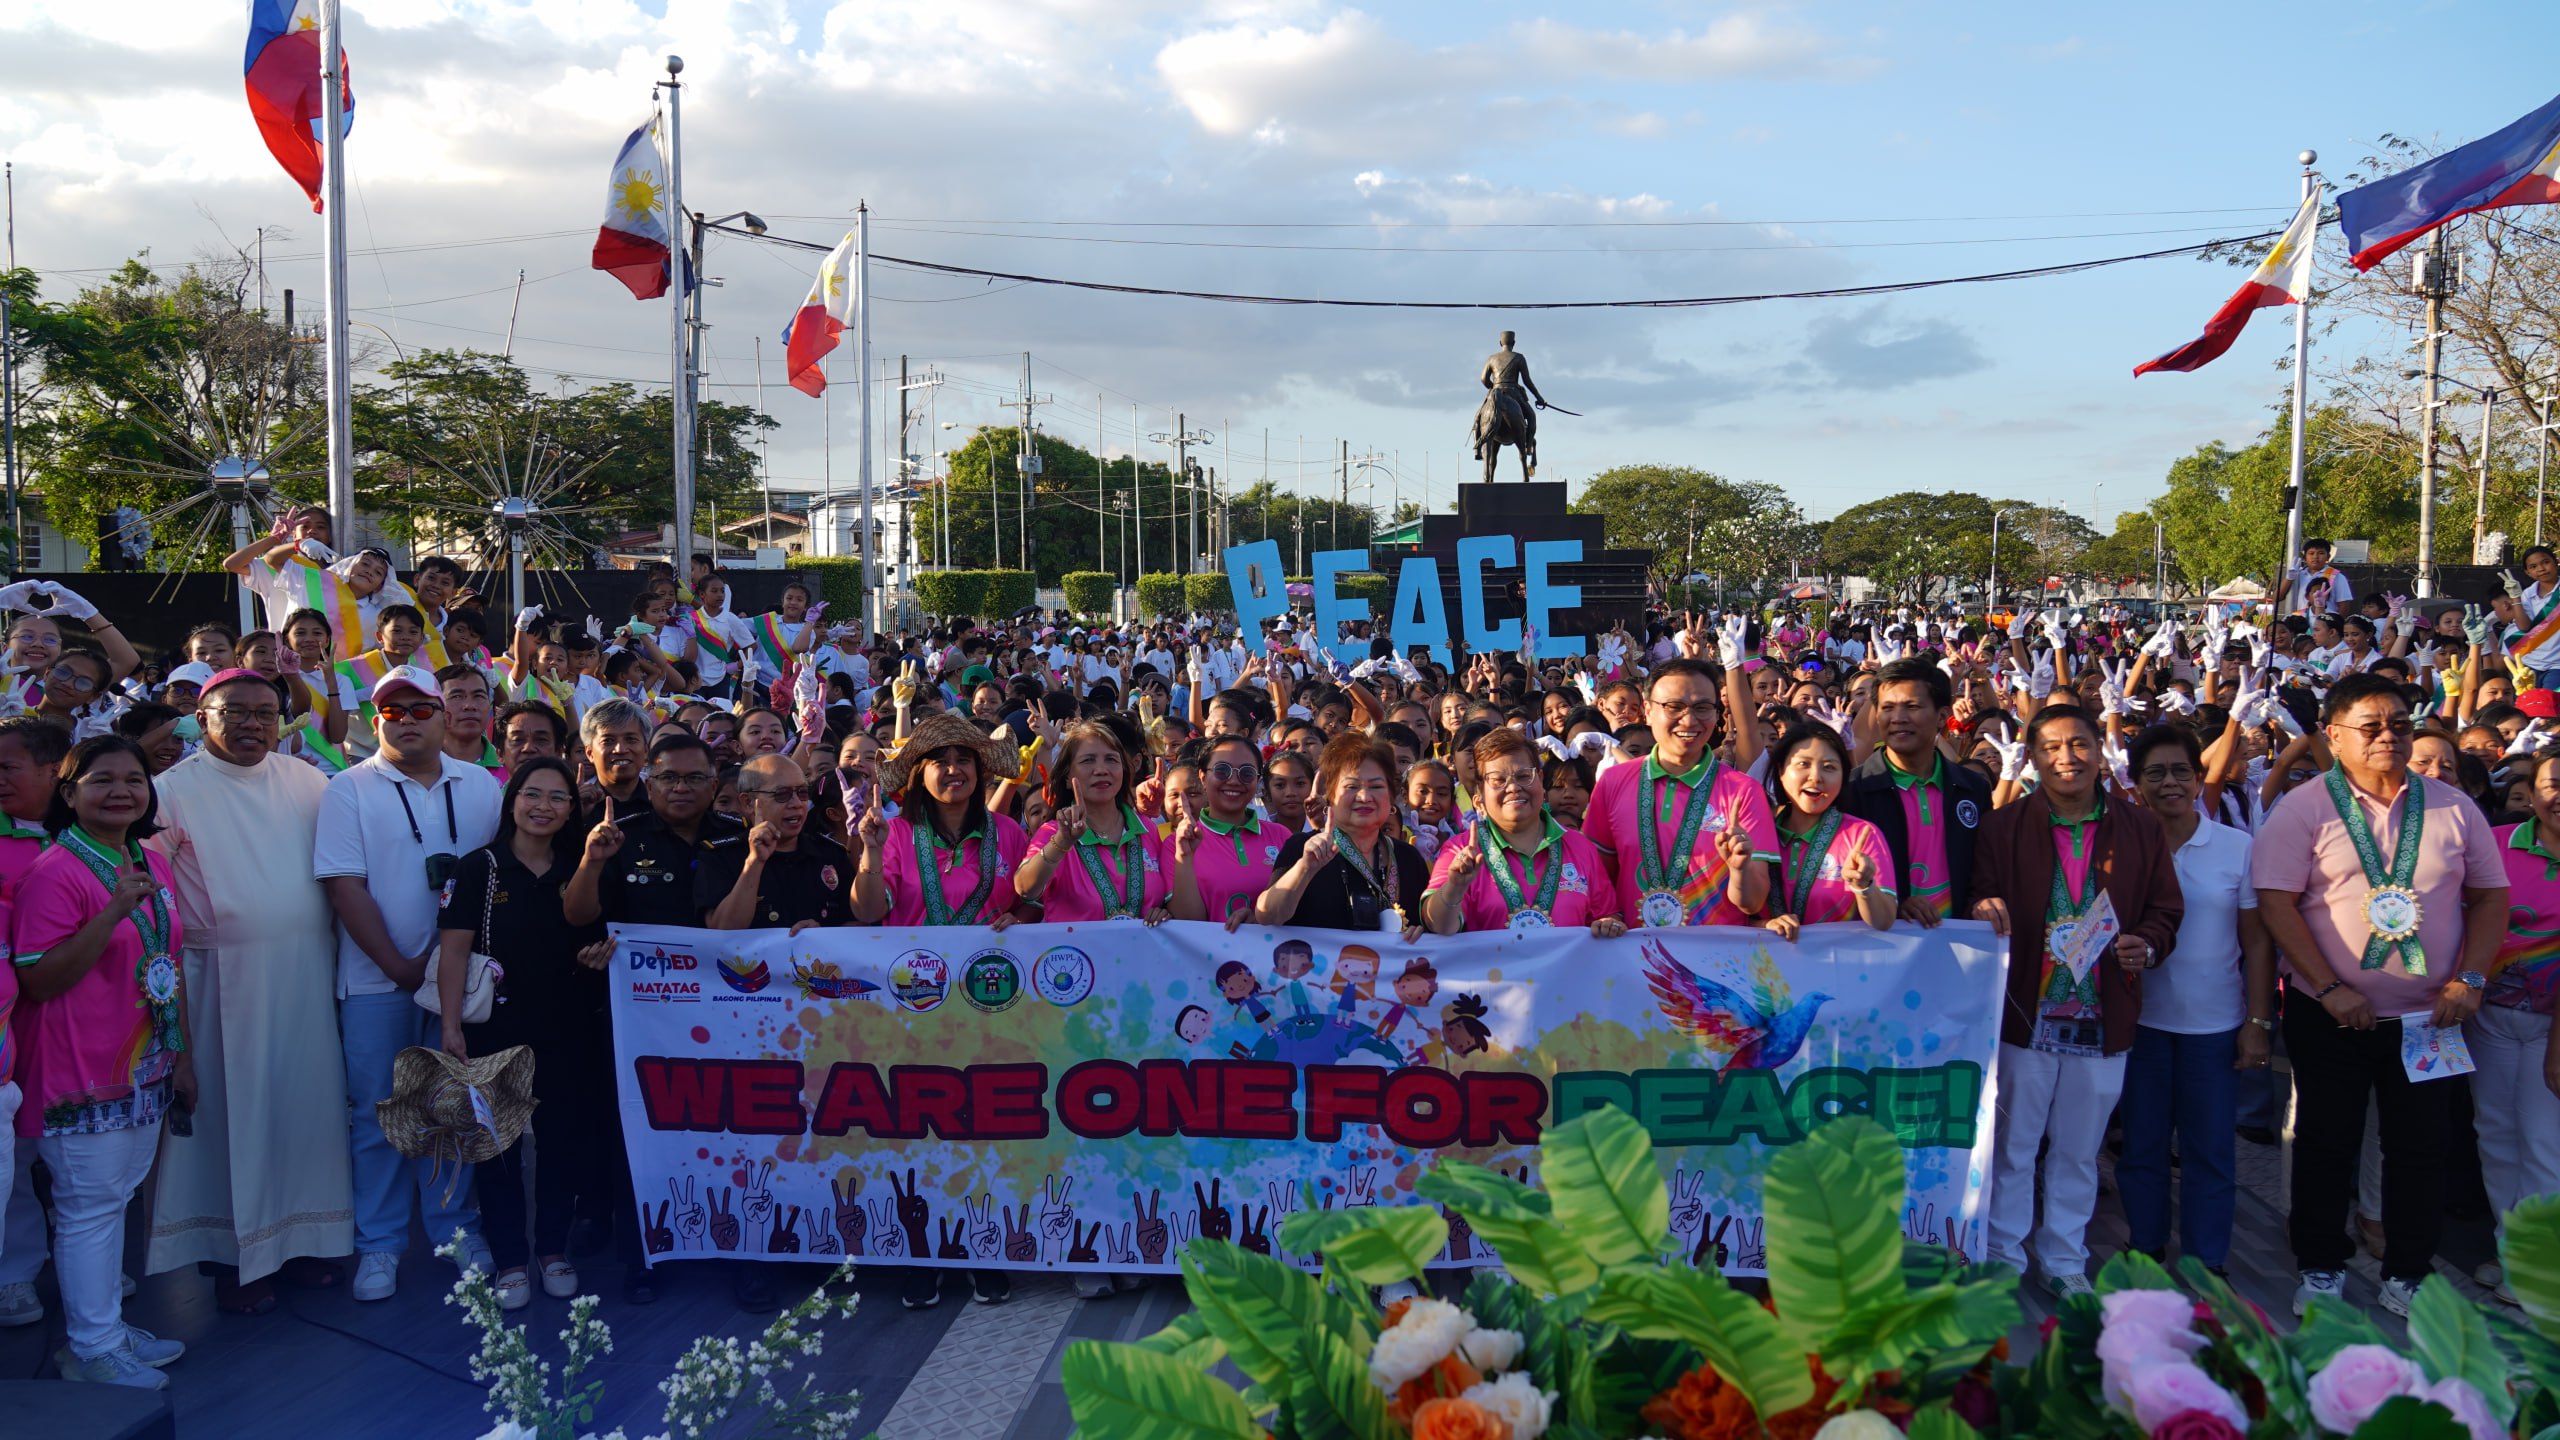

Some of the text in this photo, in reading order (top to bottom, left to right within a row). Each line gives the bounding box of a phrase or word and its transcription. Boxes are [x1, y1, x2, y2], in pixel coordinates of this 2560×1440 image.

[1223, 535, 1586, 675] PEACE
[1648, 893, 1680, 908] PEACE WALK
[2374, 892, 2411, 906] PEACE WALK
[1515, 911, 1548, 925] PEACE WALK
[2056, 923, 2075, 934] PEACE
[150, 957, 162, 970] PEACE
[630, 945, 698, 977] DepED
[908, 959, 940, 969] KAWIT
[1051, 953, 1076, 962] HWPL
[632, 982, 701, 994] MATATAG
[840, 990, 872, 1001] CAVITE
[635, 1055, 1982, 1150] WE ARE ONE FOR PEACE!
